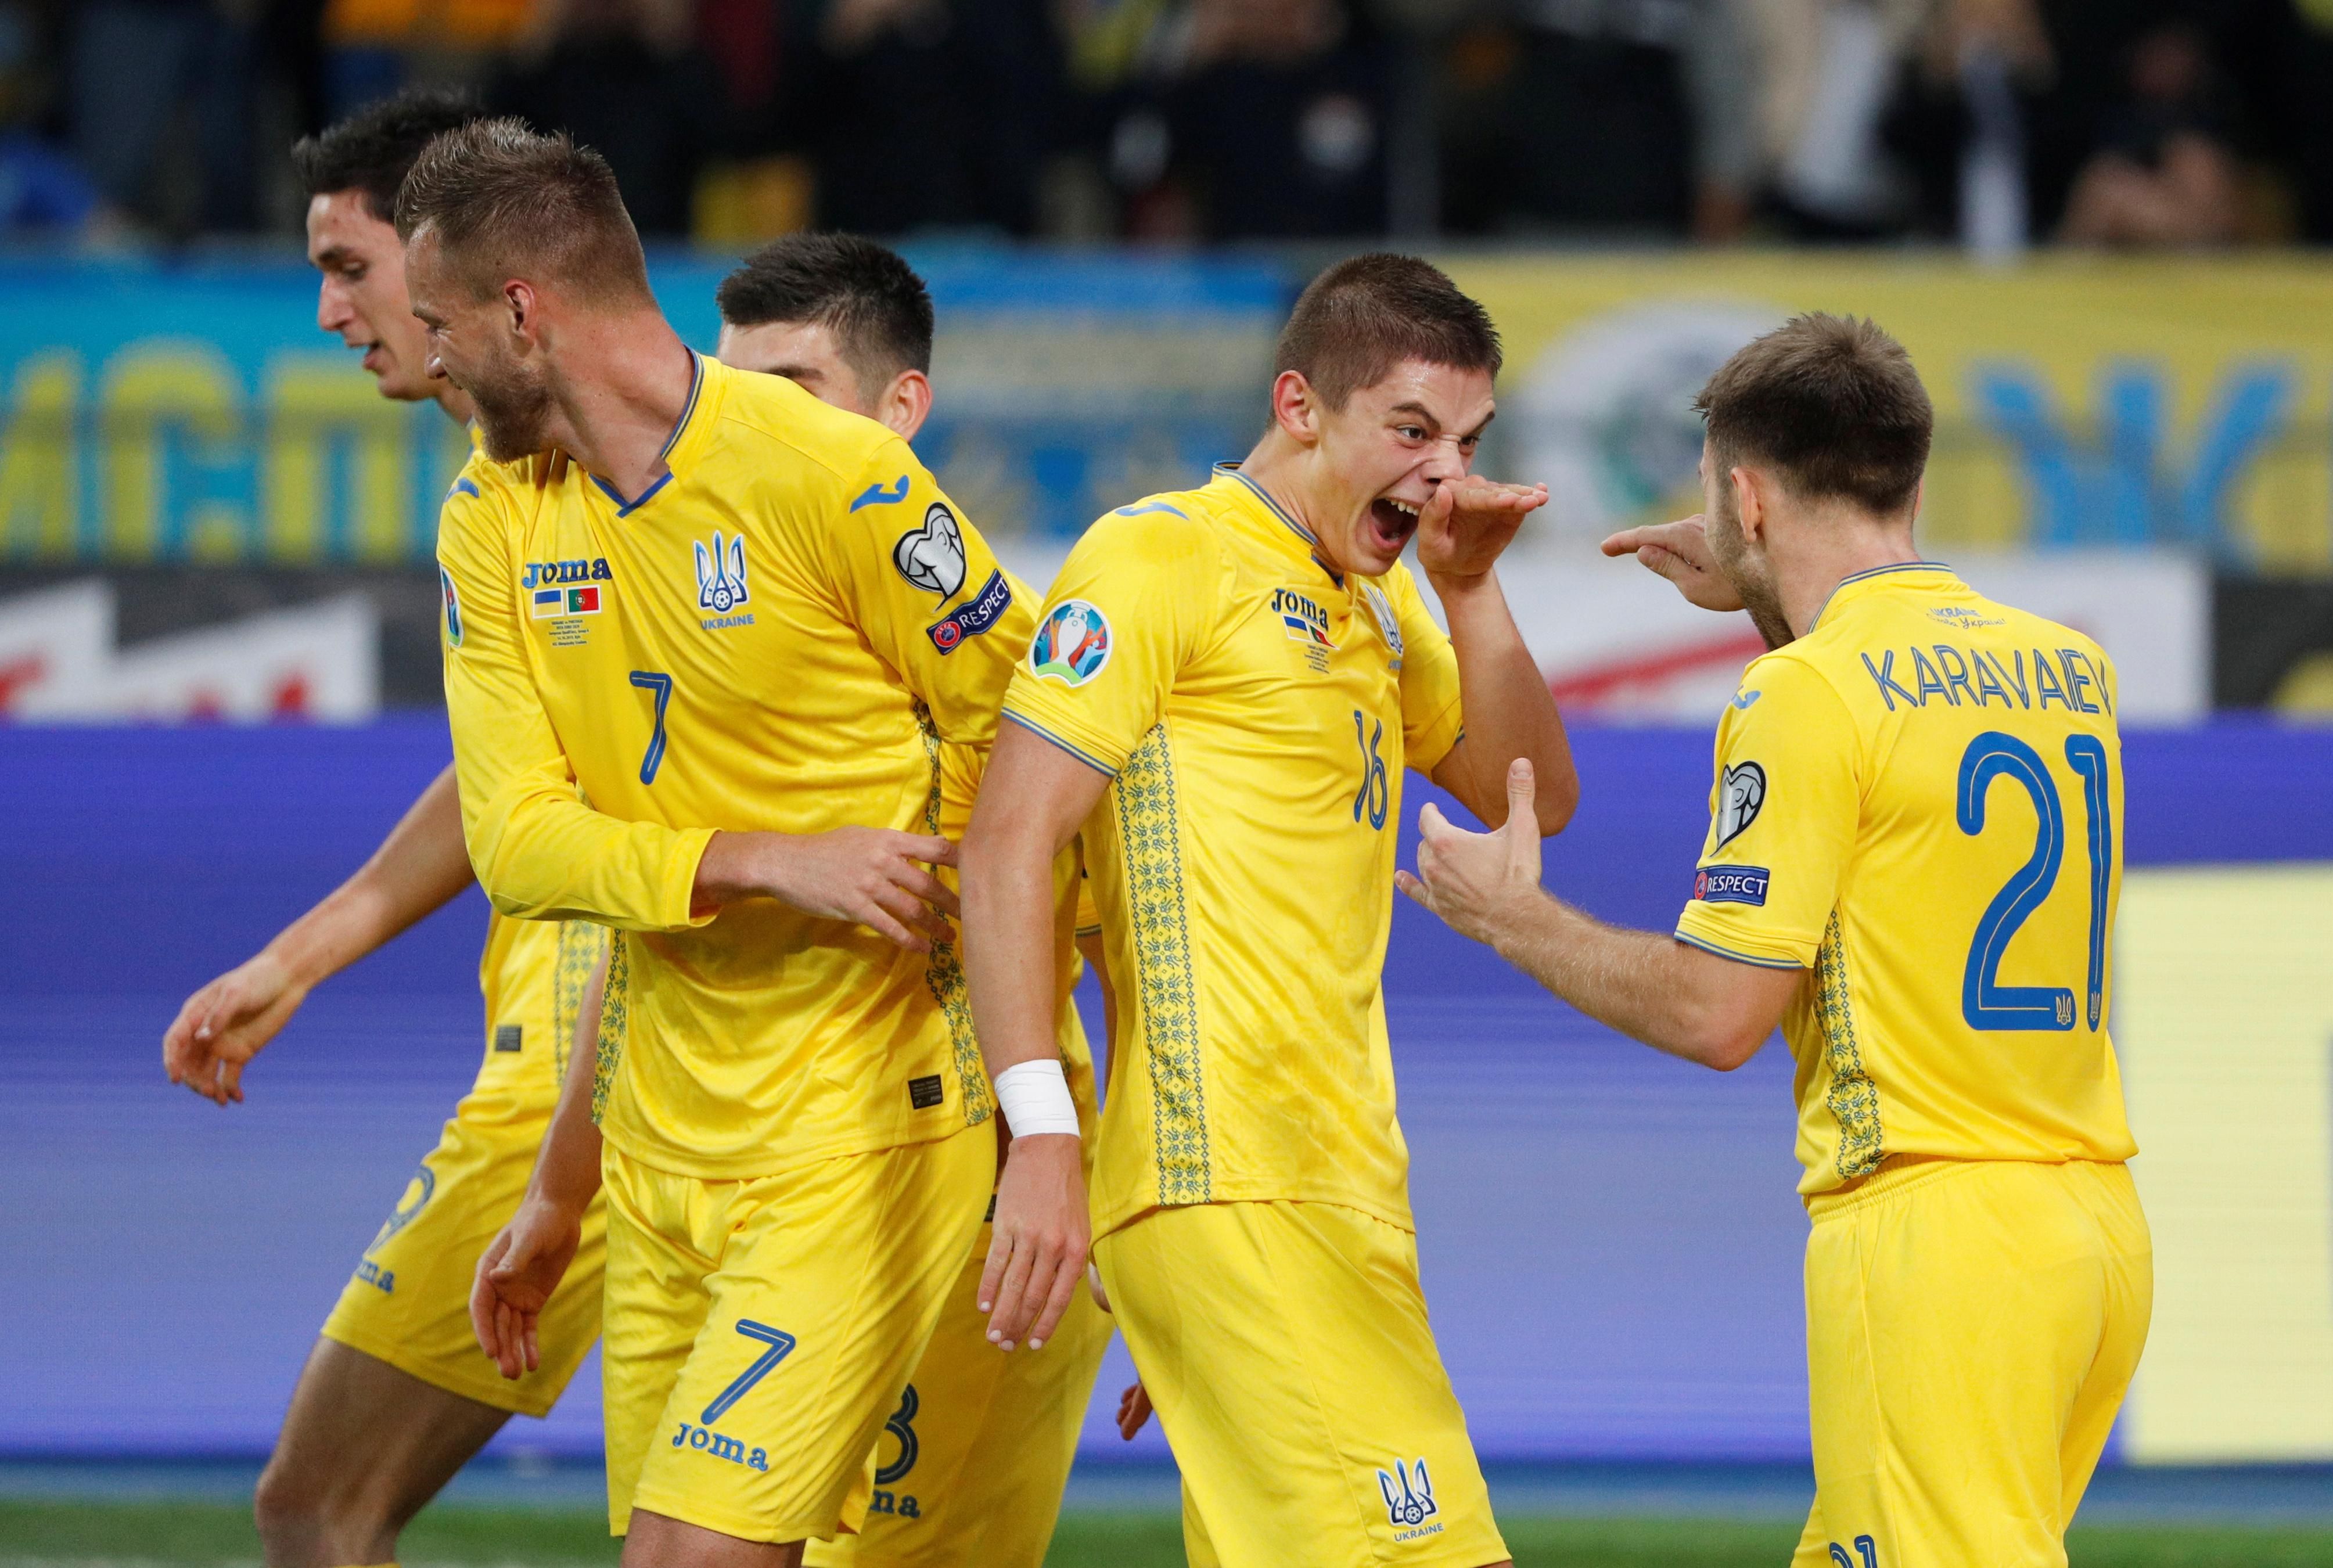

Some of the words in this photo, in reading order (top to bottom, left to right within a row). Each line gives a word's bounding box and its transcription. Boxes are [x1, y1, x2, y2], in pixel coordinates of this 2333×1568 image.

[700, 614, 754, 630] UKRAINE
[958, 577, 1008, 628] RESPECT
[1861, 645, 2112, 717] KARAVAIEV
[629, 670, 673, 785] 7
[1354, 710, 1387, 830] 16
[1707, 876, 1767, 895] RESPECT
[1957, 731, 2112, 1032] 21
[700, 1319, 796, 1425] 7
[1394, 1522, 1444, 1542] UKRAINE
